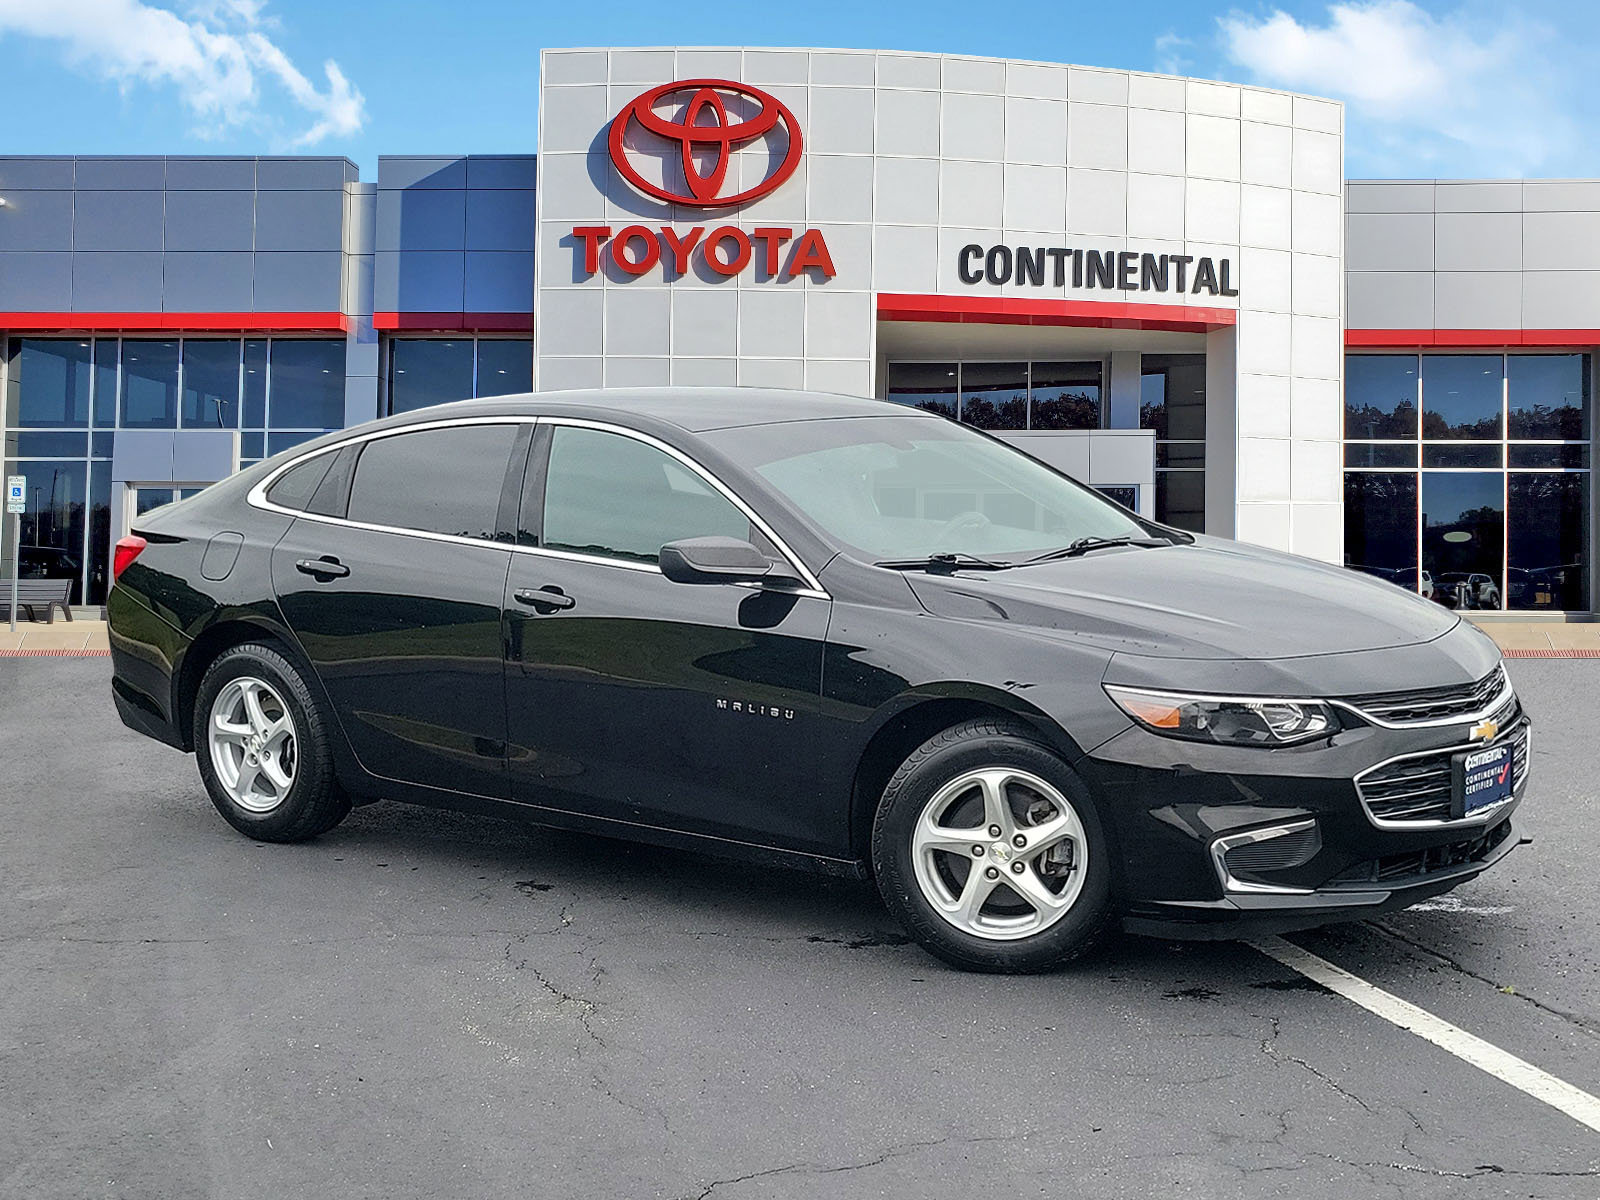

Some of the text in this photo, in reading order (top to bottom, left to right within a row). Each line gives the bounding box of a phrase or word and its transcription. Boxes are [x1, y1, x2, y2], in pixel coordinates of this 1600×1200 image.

[572, 225, 837, 276] TOYOTA
[958, 244, 1239, 297] CONTINENTAL
[716, 699, 794, 719] MALIBU
[1465, 765, 1504, 785] CONTINENTAL
[1465, 779, 1493, 795] CERTIFIED
